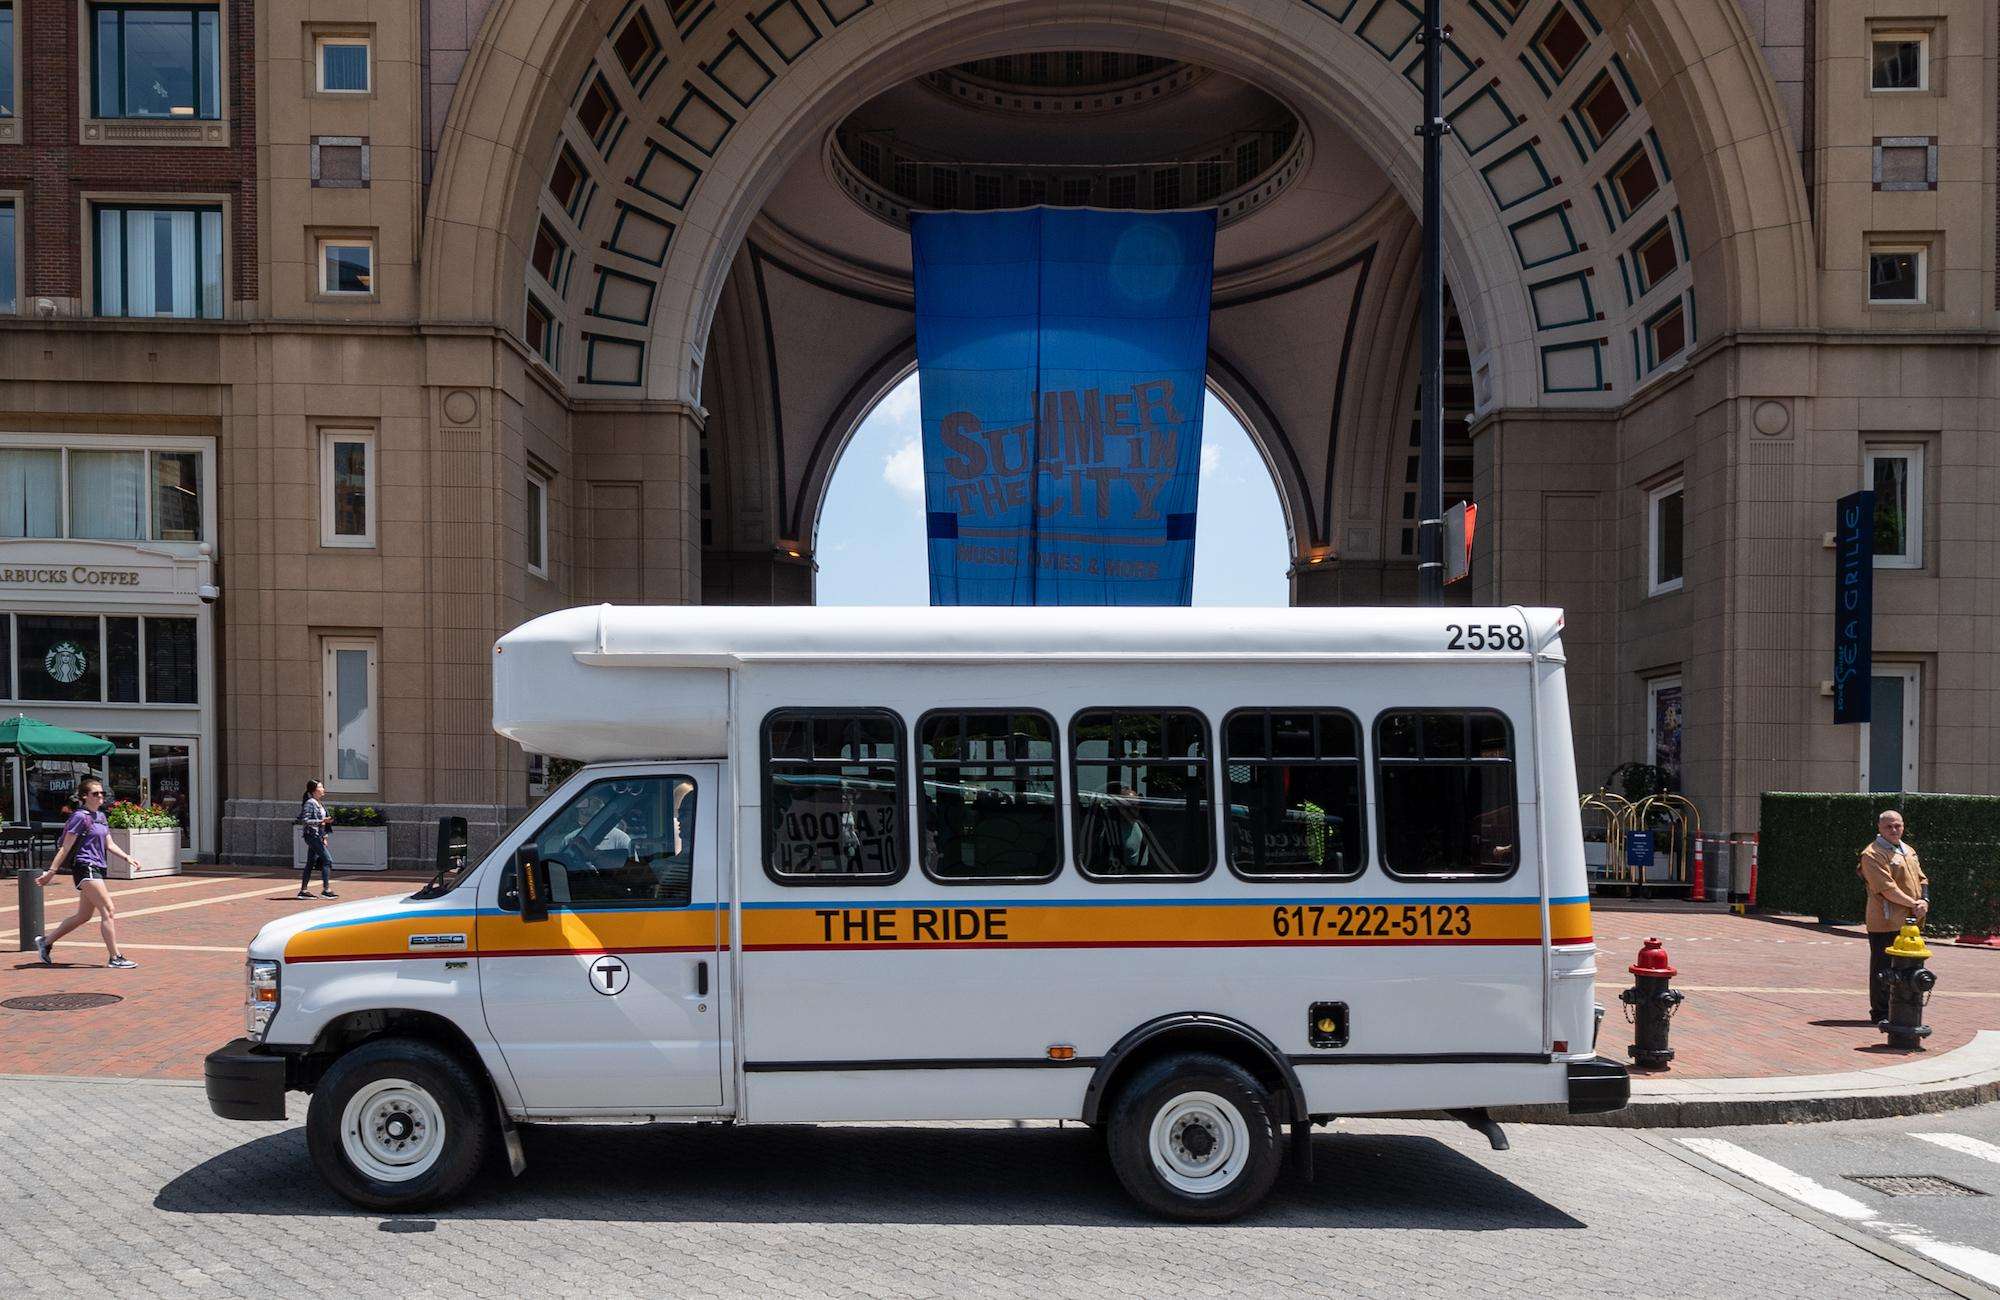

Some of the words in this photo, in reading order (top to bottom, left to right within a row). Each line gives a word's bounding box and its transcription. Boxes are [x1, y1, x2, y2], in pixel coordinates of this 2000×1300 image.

[1127, 431, 1178, 468] IN
[946, 479, 1027, 518] THE
[1029, 461, 1172, 520] CITY
[1844, 506, 1859, 611] GRILLE
[1446, 624, 1524, 650] 2558
[49, 779, 75, 792] DRAFT
[815, 909, 897, 941] THE
[913, 908, 1008, 940] RIDE
[1273, 905, 1471, 937] 617-222-5123
[597, 965, 621, 988] T
